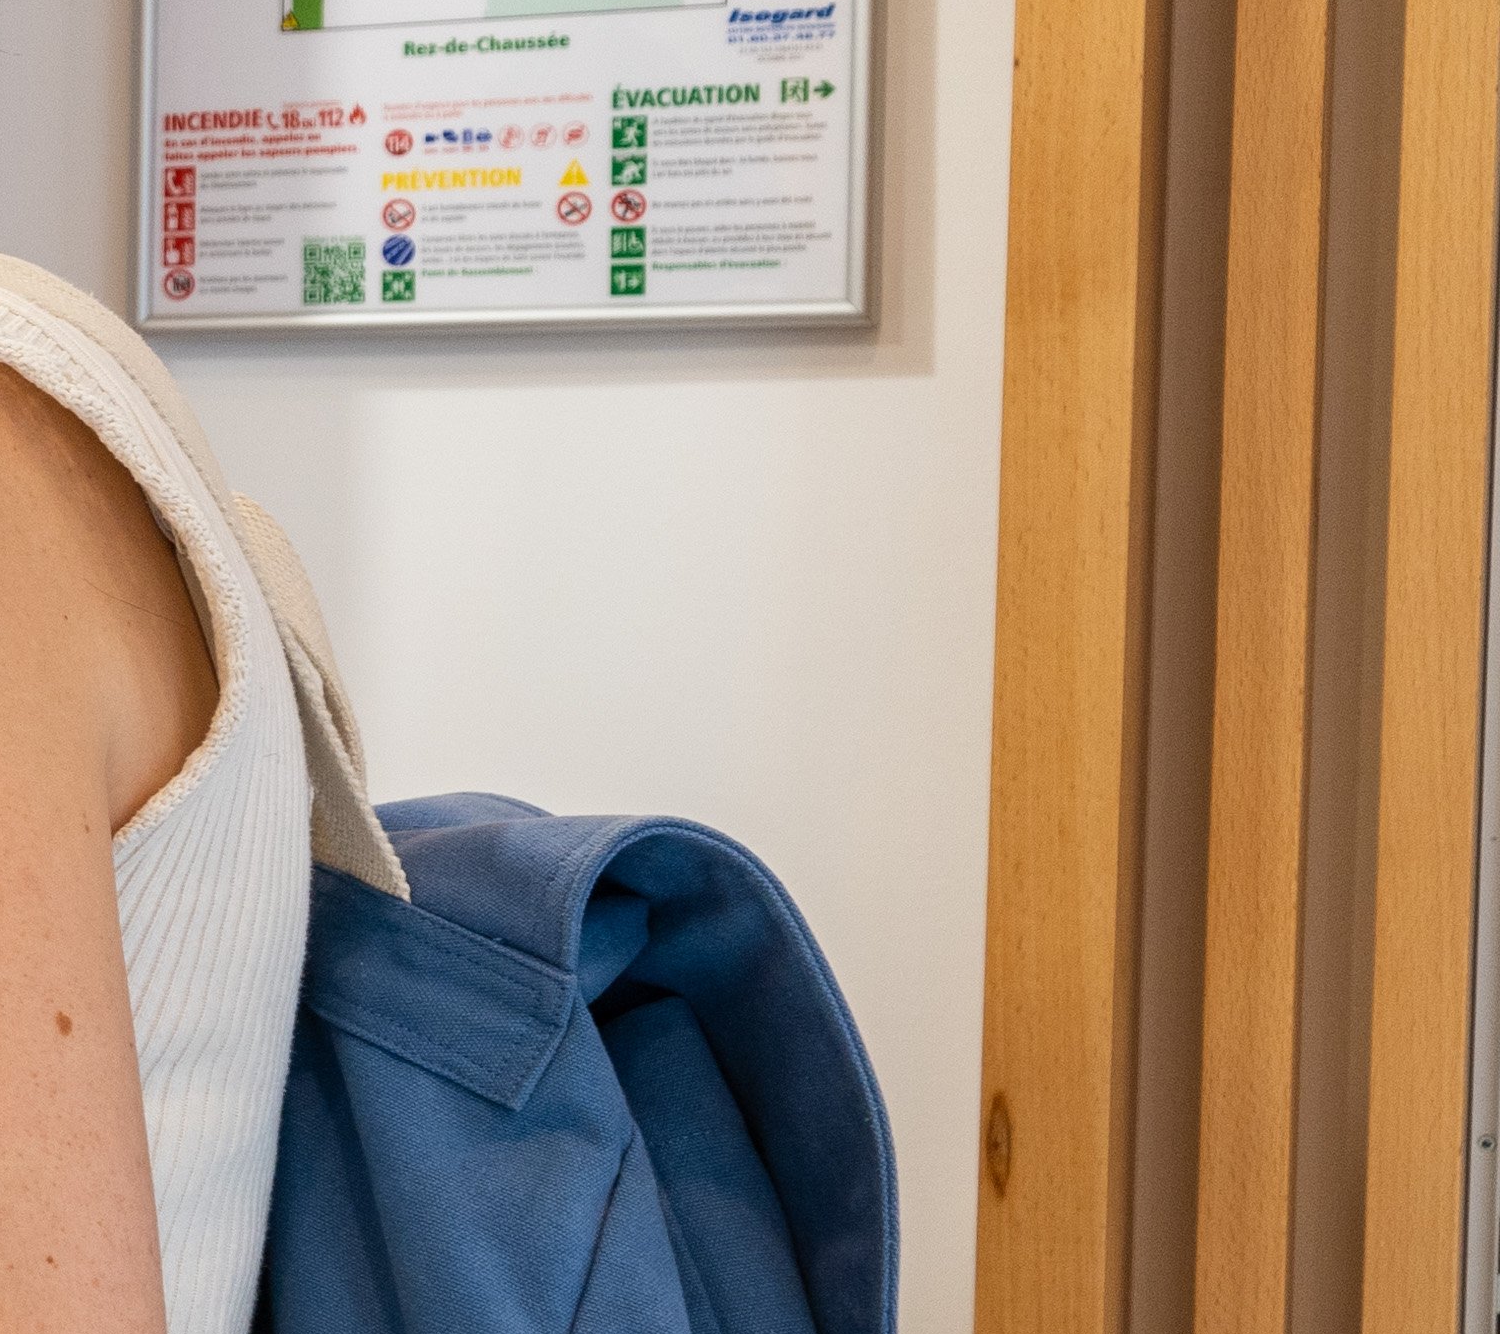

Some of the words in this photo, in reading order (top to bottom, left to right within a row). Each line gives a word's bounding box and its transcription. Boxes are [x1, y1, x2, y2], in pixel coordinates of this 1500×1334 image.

[728, 2, 837, 24] Isogard
[403, 30, 571, 55] Rez-de-Chaussée
[611, 82, 761, 109] ÉVACUATION
[164, 108, 262, 131] INCENDIE
[282, 110, 299, 129] 18
[319, 107, 344, 128] 112
[381, 167, 522, 192] PRÉVENTION
